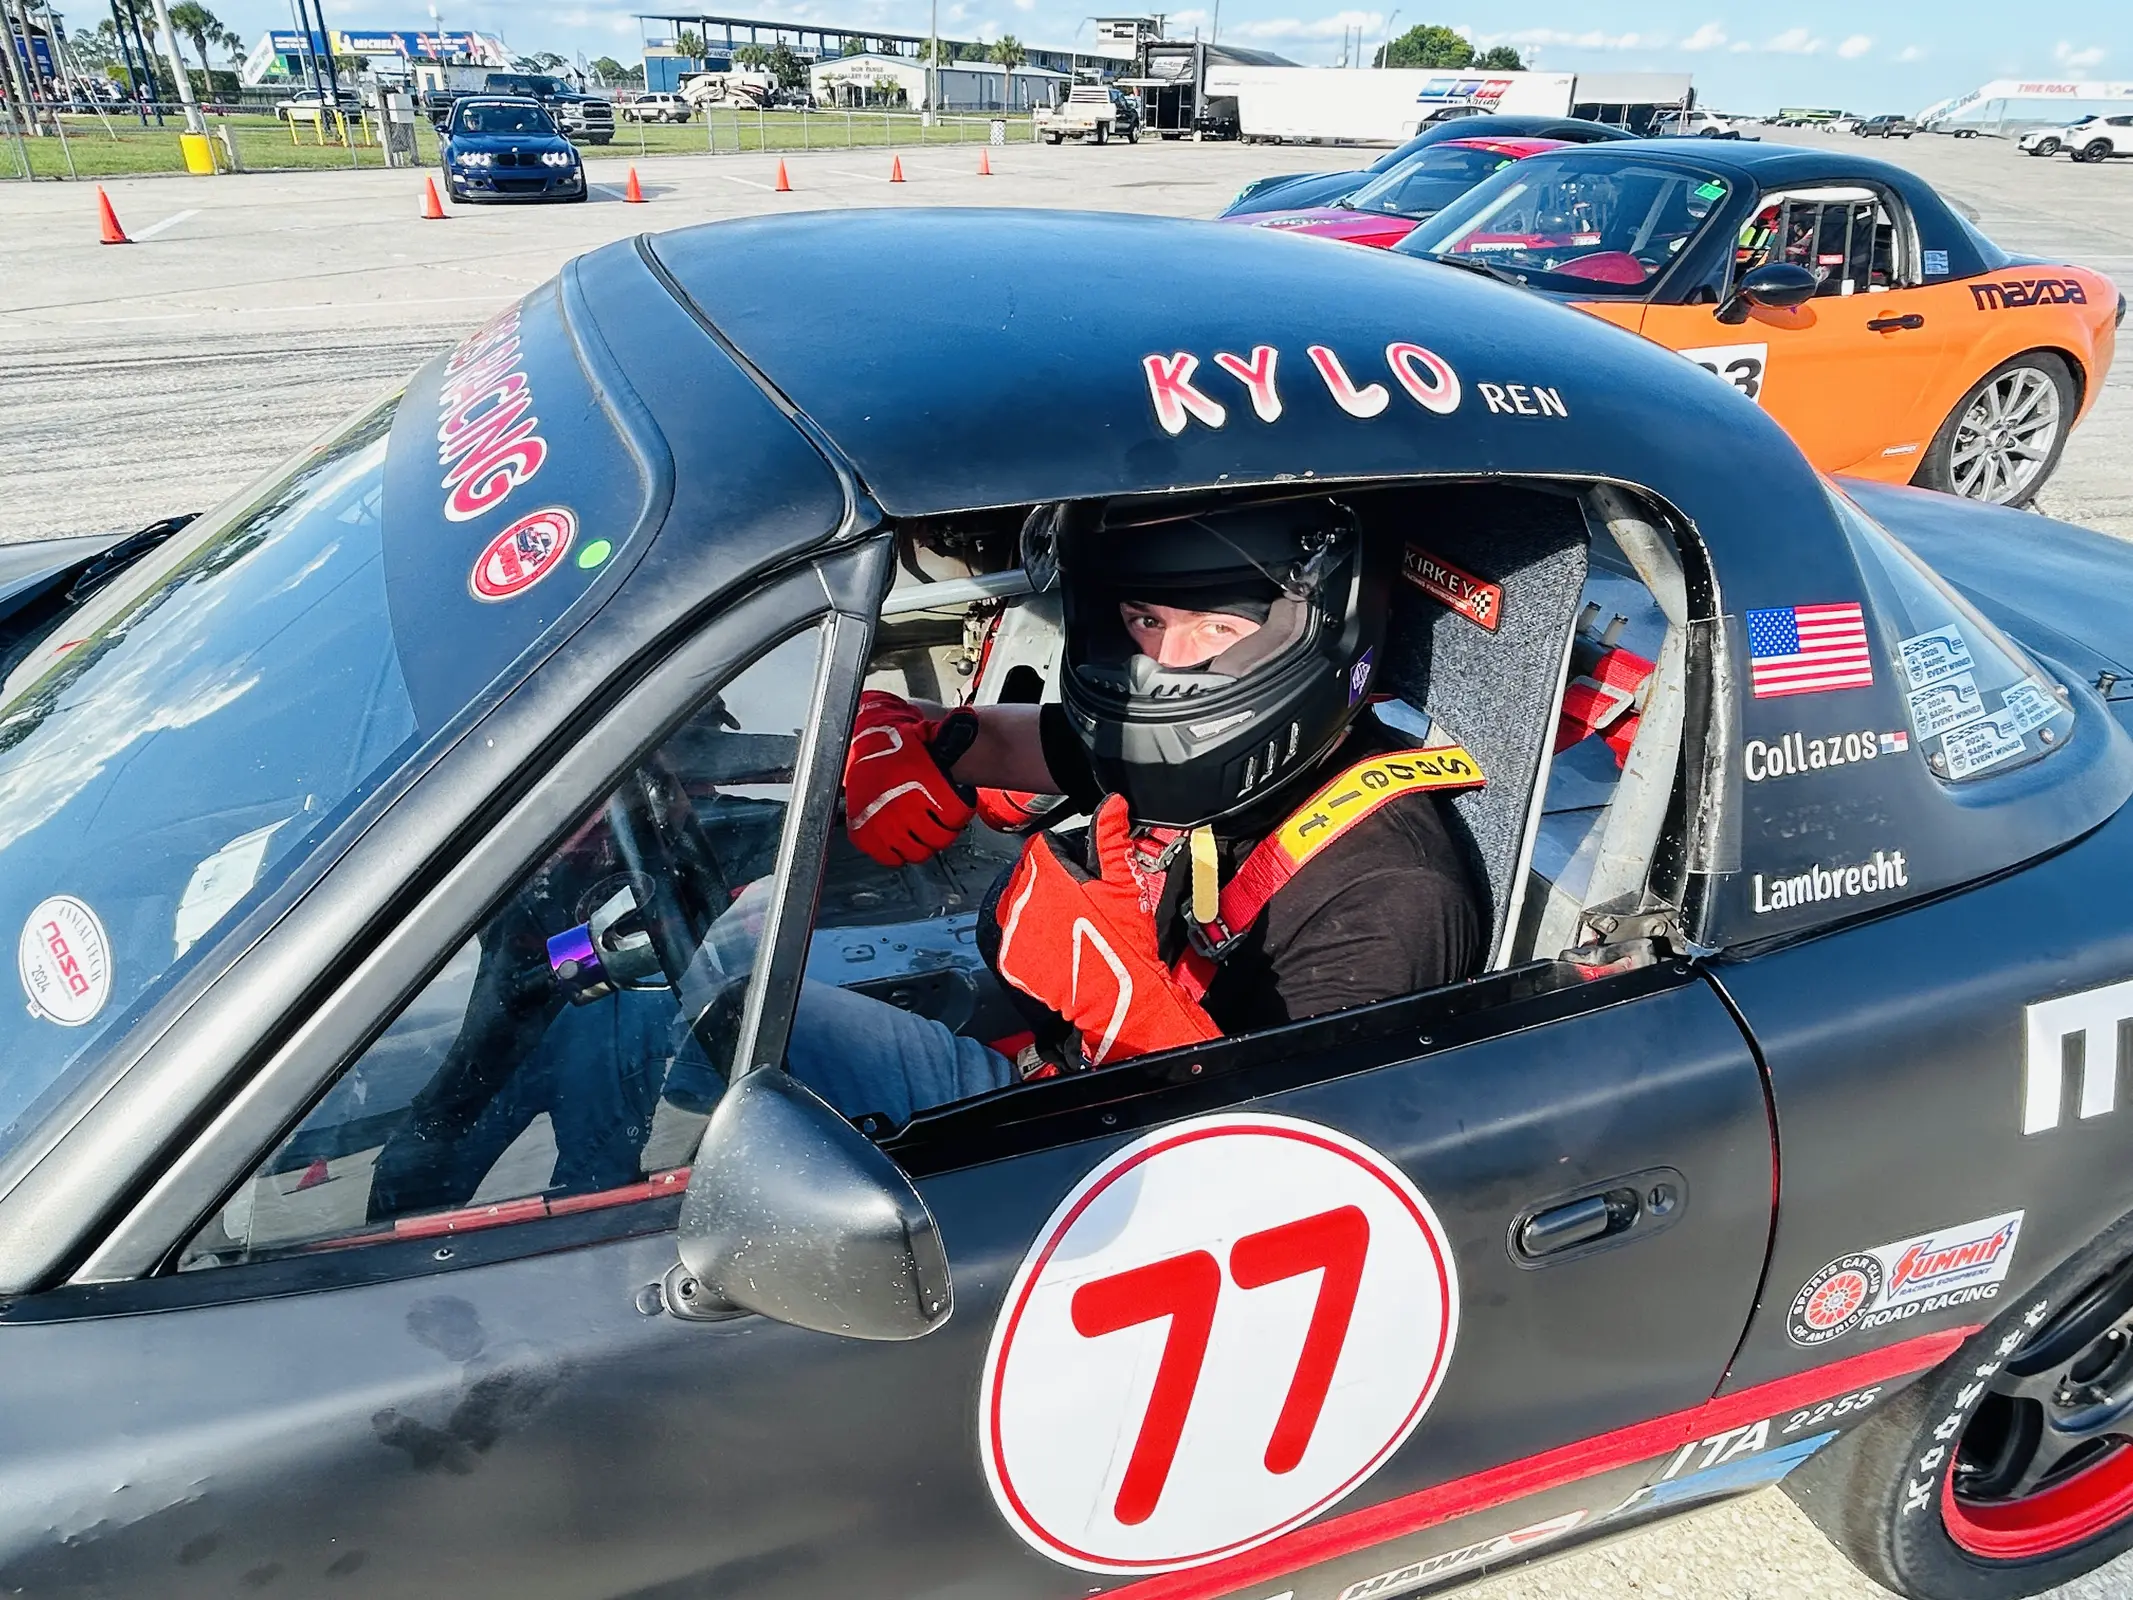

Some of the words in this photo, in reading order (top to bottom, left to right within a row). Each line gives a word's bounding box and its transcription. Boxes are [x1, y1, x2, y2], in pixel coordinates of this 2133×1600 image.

[2016, 83, 2045, 94] TIRE
[2045, 84, 2080, 97] RACK
[1143, 341, 1462, 436] KYLO
[1477, 382, 1569, 418] REN
[1695, 357, 1762, 399] 3
[437, 335, 548, 523] RACING
[1404, 550, 1476, 598] KIRKEY
[1927, 697, 1946, 709] 2024
[1932, 715, 1955, 730] EVENT
[1956, 705, 1982, 720] WINNER
[1745, 730, 1878, 782] Collazos
[1970, 751, 1994, 766] EVENT
[1995, 740, 2022, 755] WINNER
[1298, 756, 1472, 837] Sabelt
[1754, 850, 1908, 914] Lambrecht
[31, 964, 51, 993] 2024
[42, 921, 90, 997] nasa
[1792, 1264, 1838, 1315] SPORTS
[1842, 1257, 1869, 1274] CAR
[1868, 1262, 1883, 1295] CLUB
[1859, 1301, 1922, 1331] ROAD
[1921, 1282, 2000, 1314] RACING
[1899, 1280, 1934, 1296] RACING
[1793, 1324, 1804, 1340] OF
[1805, 1308, 1867, 1342] AMERICA
[1071, 1204, 1370, 1526] 77
[1663, 1418, 1770, 1480] ITA
[1781, 1386, 1882, 1434] 2255
[1348, 1537, 1503, 1599] HAWK
